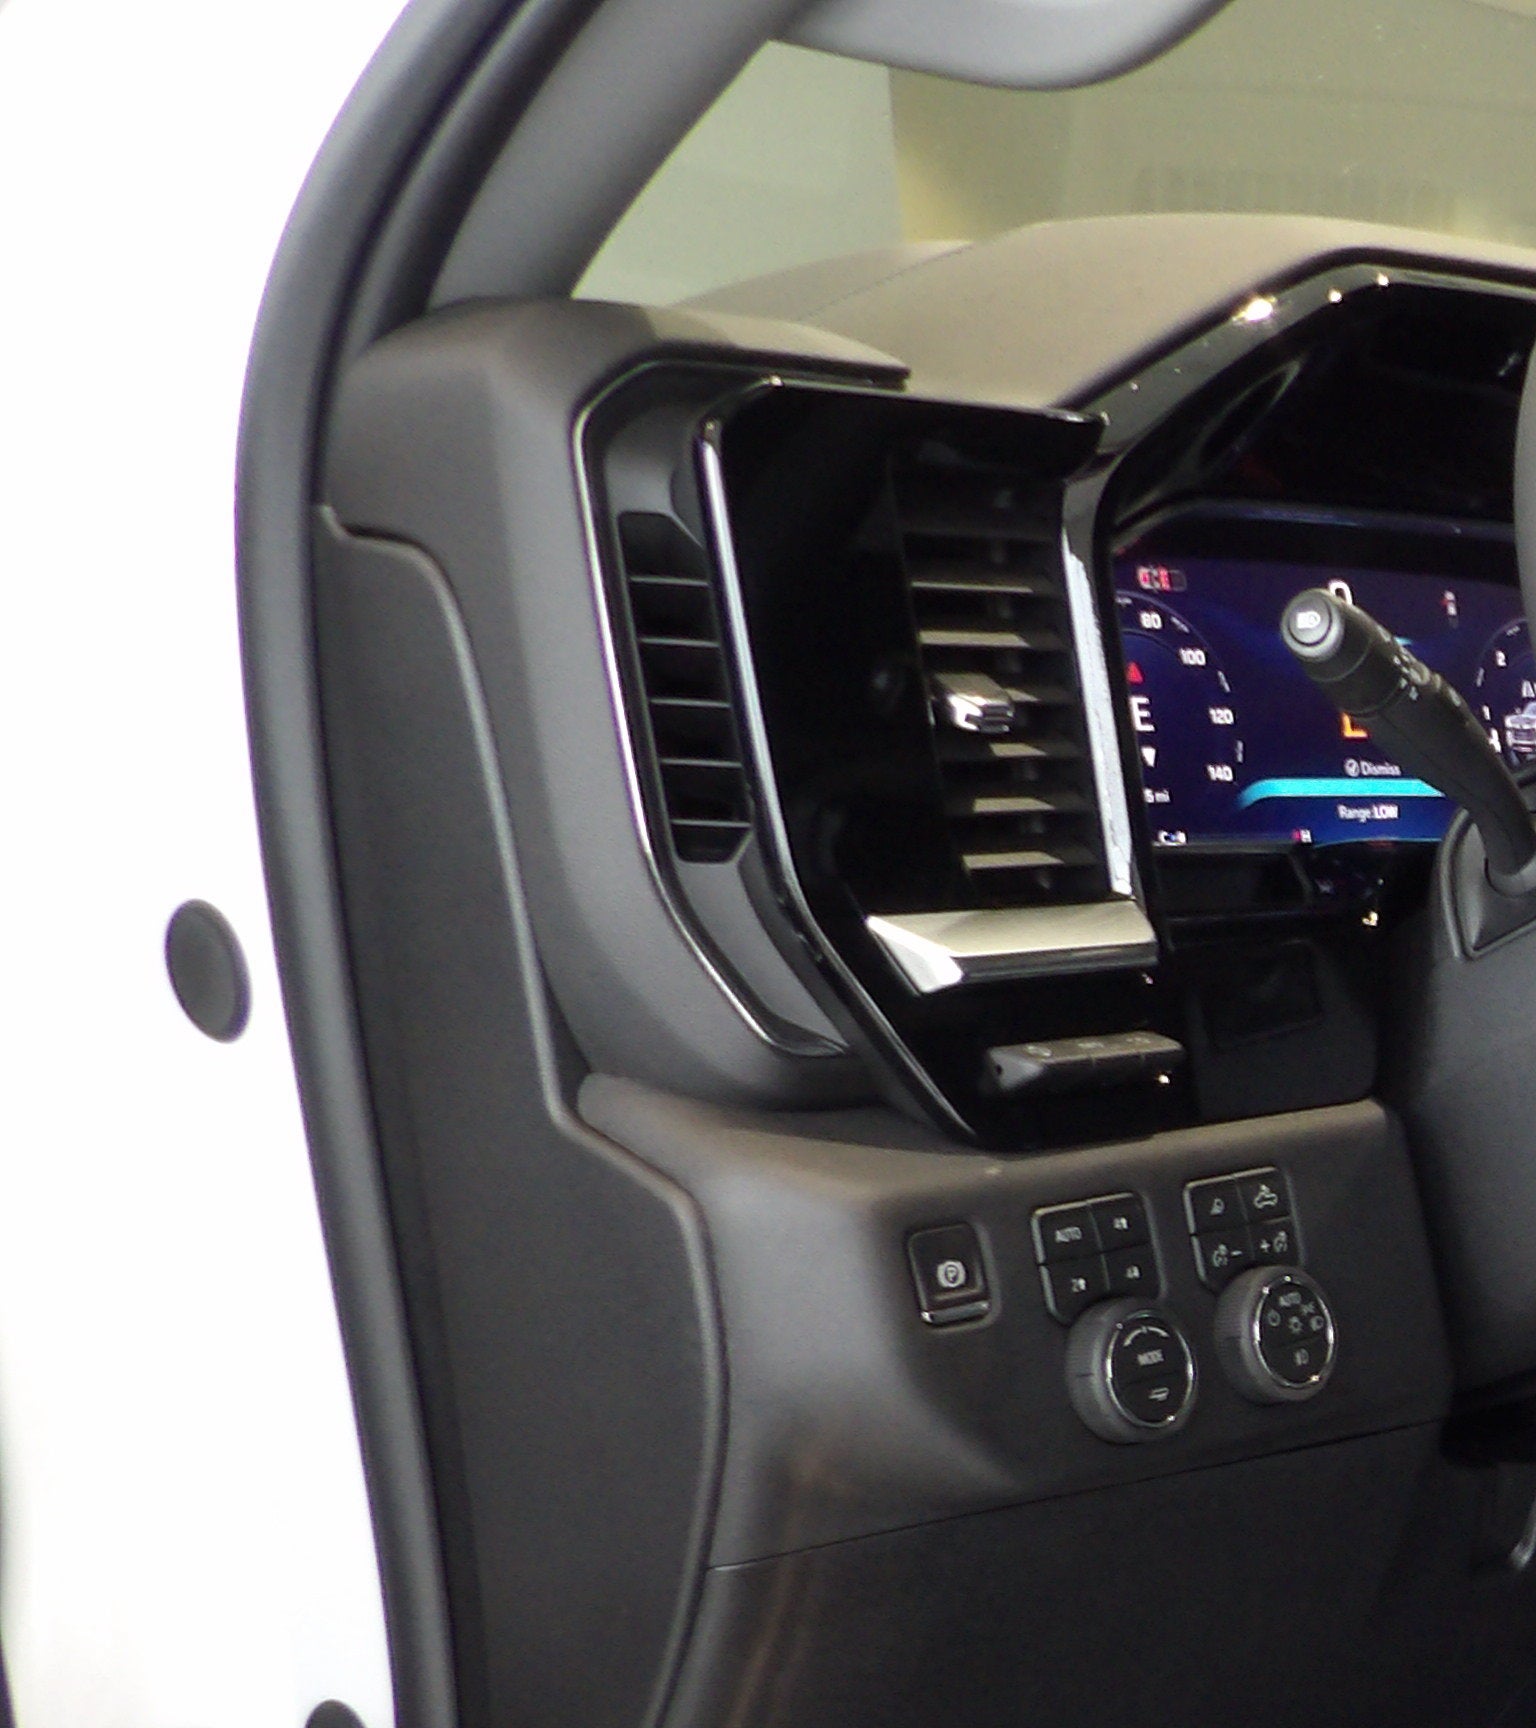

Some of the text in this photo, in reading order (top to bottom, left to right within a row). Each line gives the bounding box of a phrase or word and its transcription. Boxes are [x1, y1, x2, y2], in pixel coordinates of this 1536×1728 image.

[1140, 612, 1162, 630] 80
[1180, 649, 1206, 667] 100
[1129, 696, 1155, 732] E
[1209, 707, 1234, 725] 120
[1207, 764, 1233, 782] 140
[1360, 760, 1402, 776] Dismiss
[1373, 805, 1399, 820] LOW
